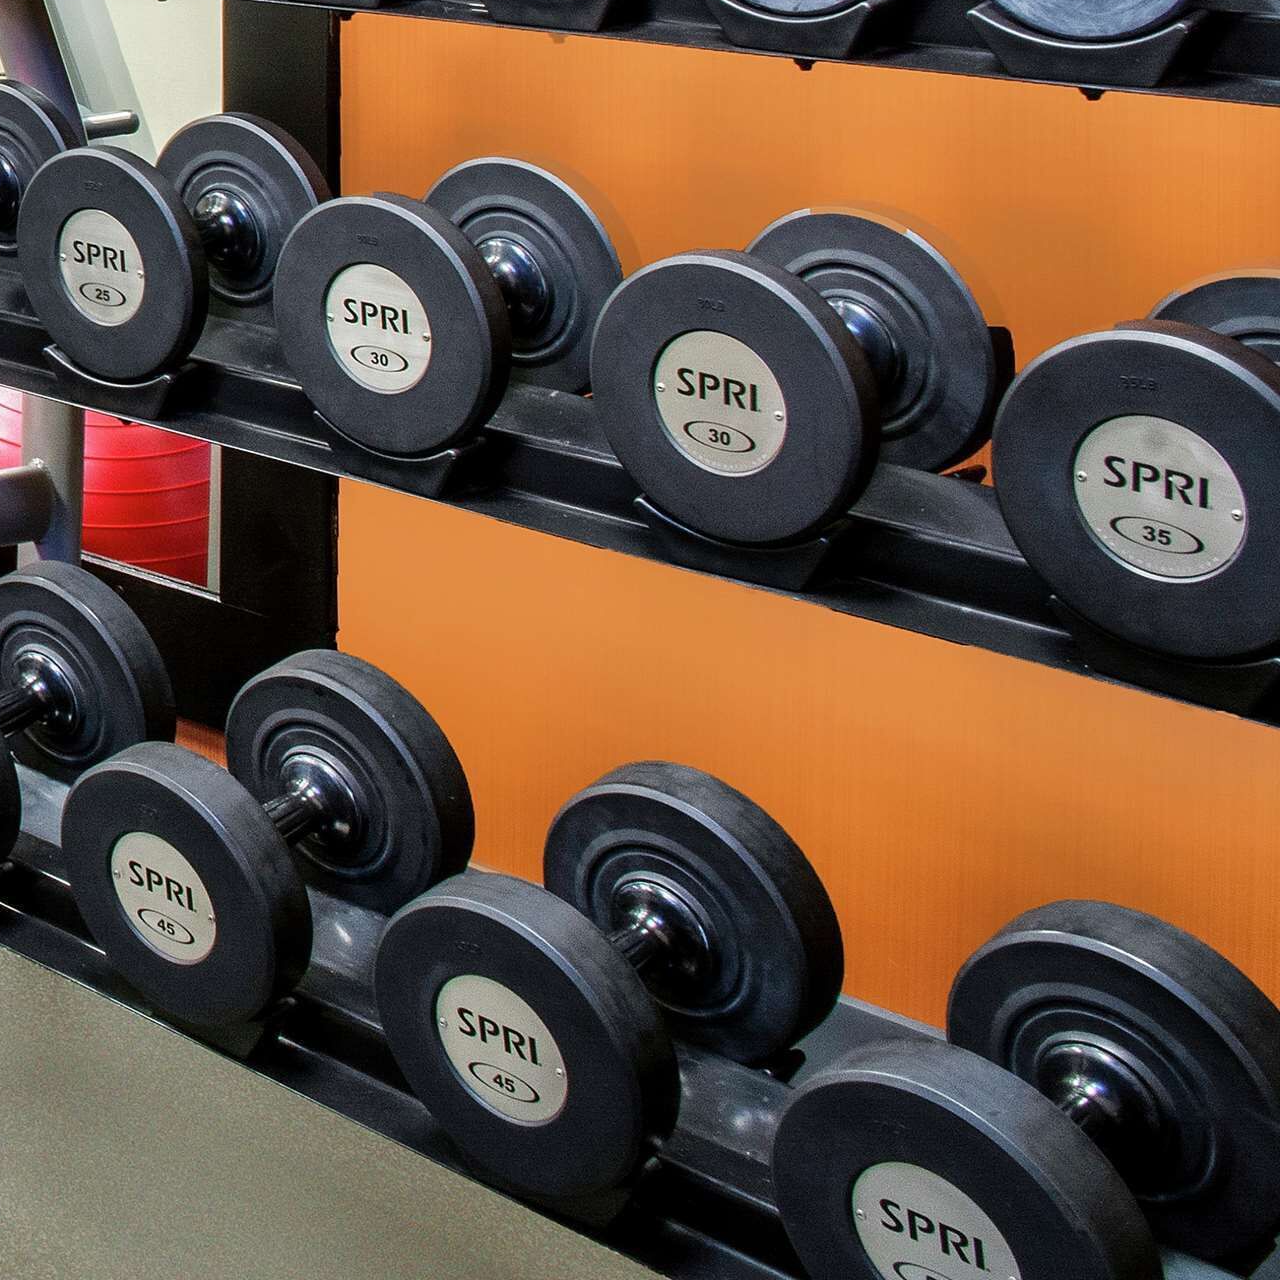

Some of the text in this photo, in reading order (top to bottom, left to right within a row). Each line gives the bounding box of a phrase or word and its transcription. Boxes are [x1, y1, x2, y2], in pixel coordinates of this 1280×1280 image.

[73, 240, 127, 273] SPRI
[95, 288, 111, 302] 25
[343, 298, 409, 335] SPRI
[370, 351, 389, 367] 30
[676, 367, 759, 413] SPRI
[707, 428, 731, 446] 30
[1103, 455, 1209, 510] SPRI
[1143, 524, 1174, 546] 35
[128, 860, 196, 912] SPRI
[156, 918, 176, 936] 45
[457, 1008, 540, 1065] SPRI
[493, 1074, 517, 1093] 45
[879, 1199, 986, 1271] SPRI
